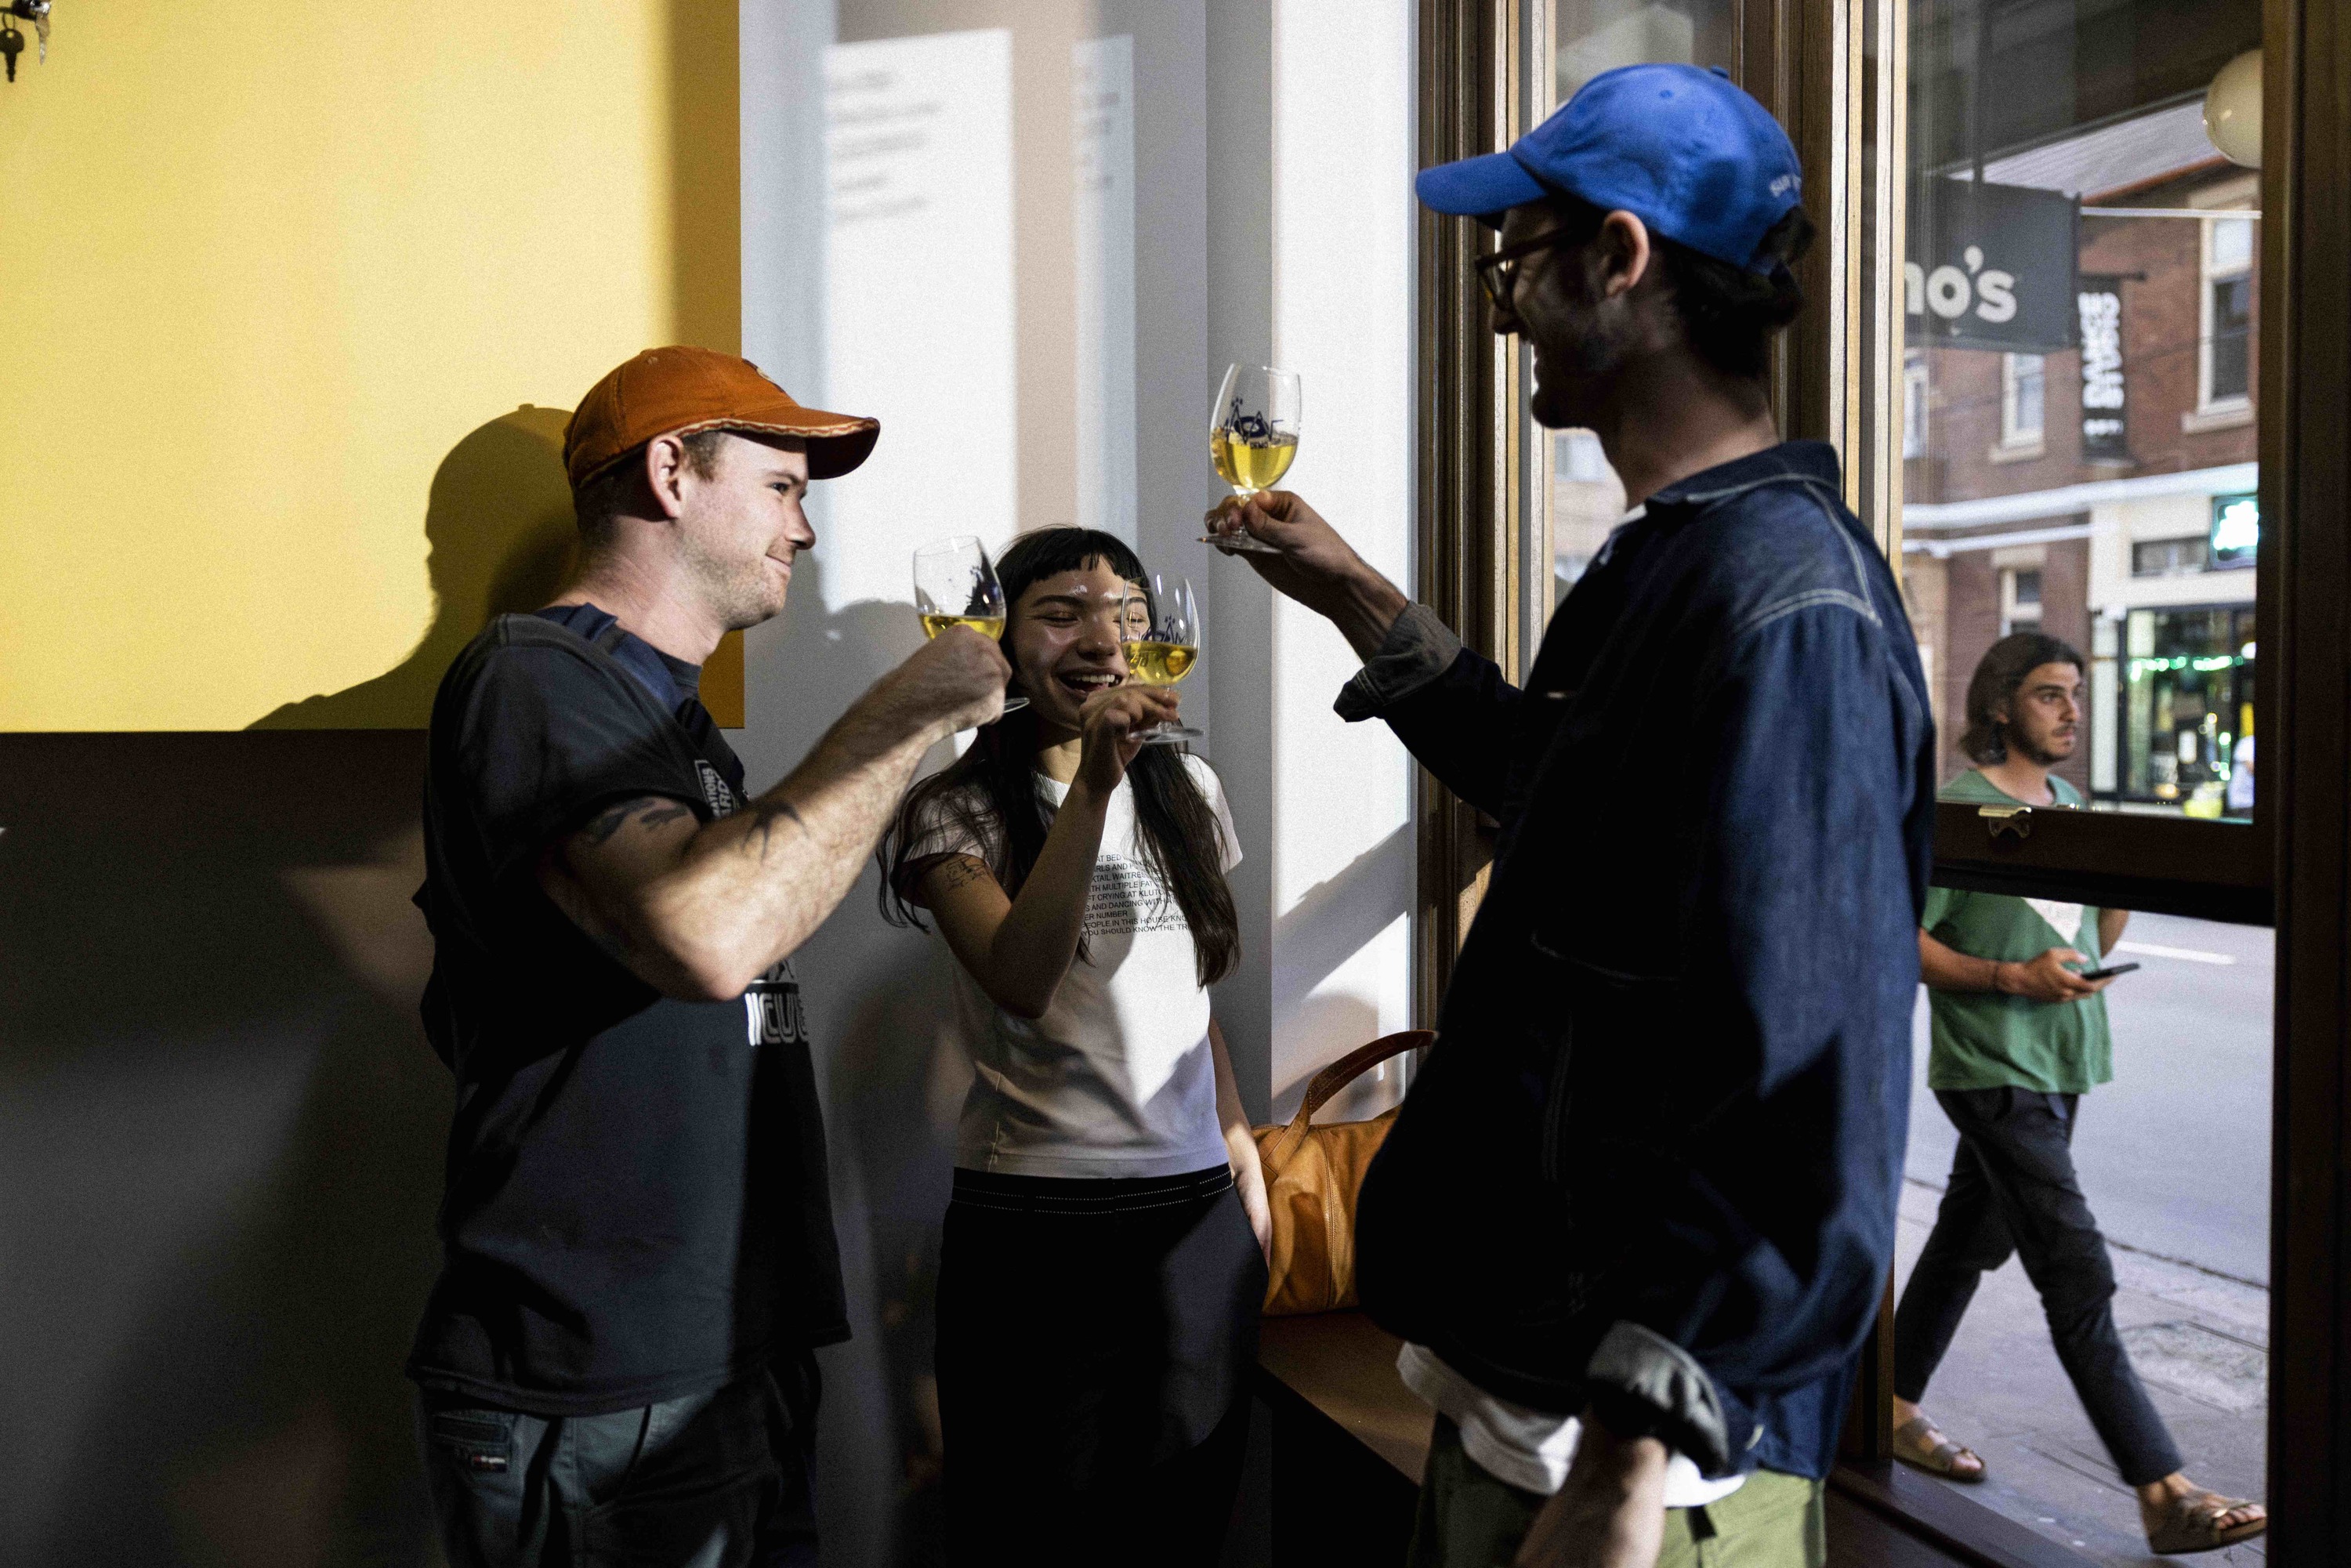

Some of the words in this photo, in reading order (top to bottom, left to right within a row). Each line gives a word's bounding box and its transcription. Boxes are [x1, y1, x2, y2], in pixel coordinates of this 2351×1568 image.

[1106, 853, 1121, 862] BED
[1102, 881, 1139, 892] MULTIPLE
[1097, 892, 1126, 901] CRYING
[1091, 903, 1107, 911] AND
[1108, 899, 1143, 910] DANCING
[1096, 910, 1128, 919] NUMBER
[1121, 918, 1139, 926] THIS
[1140, 915, 1168, 924] HOUSE
[1100, 927, 1131, 936] SHOULD
[1132, 925, 1157, 933] KNOW
